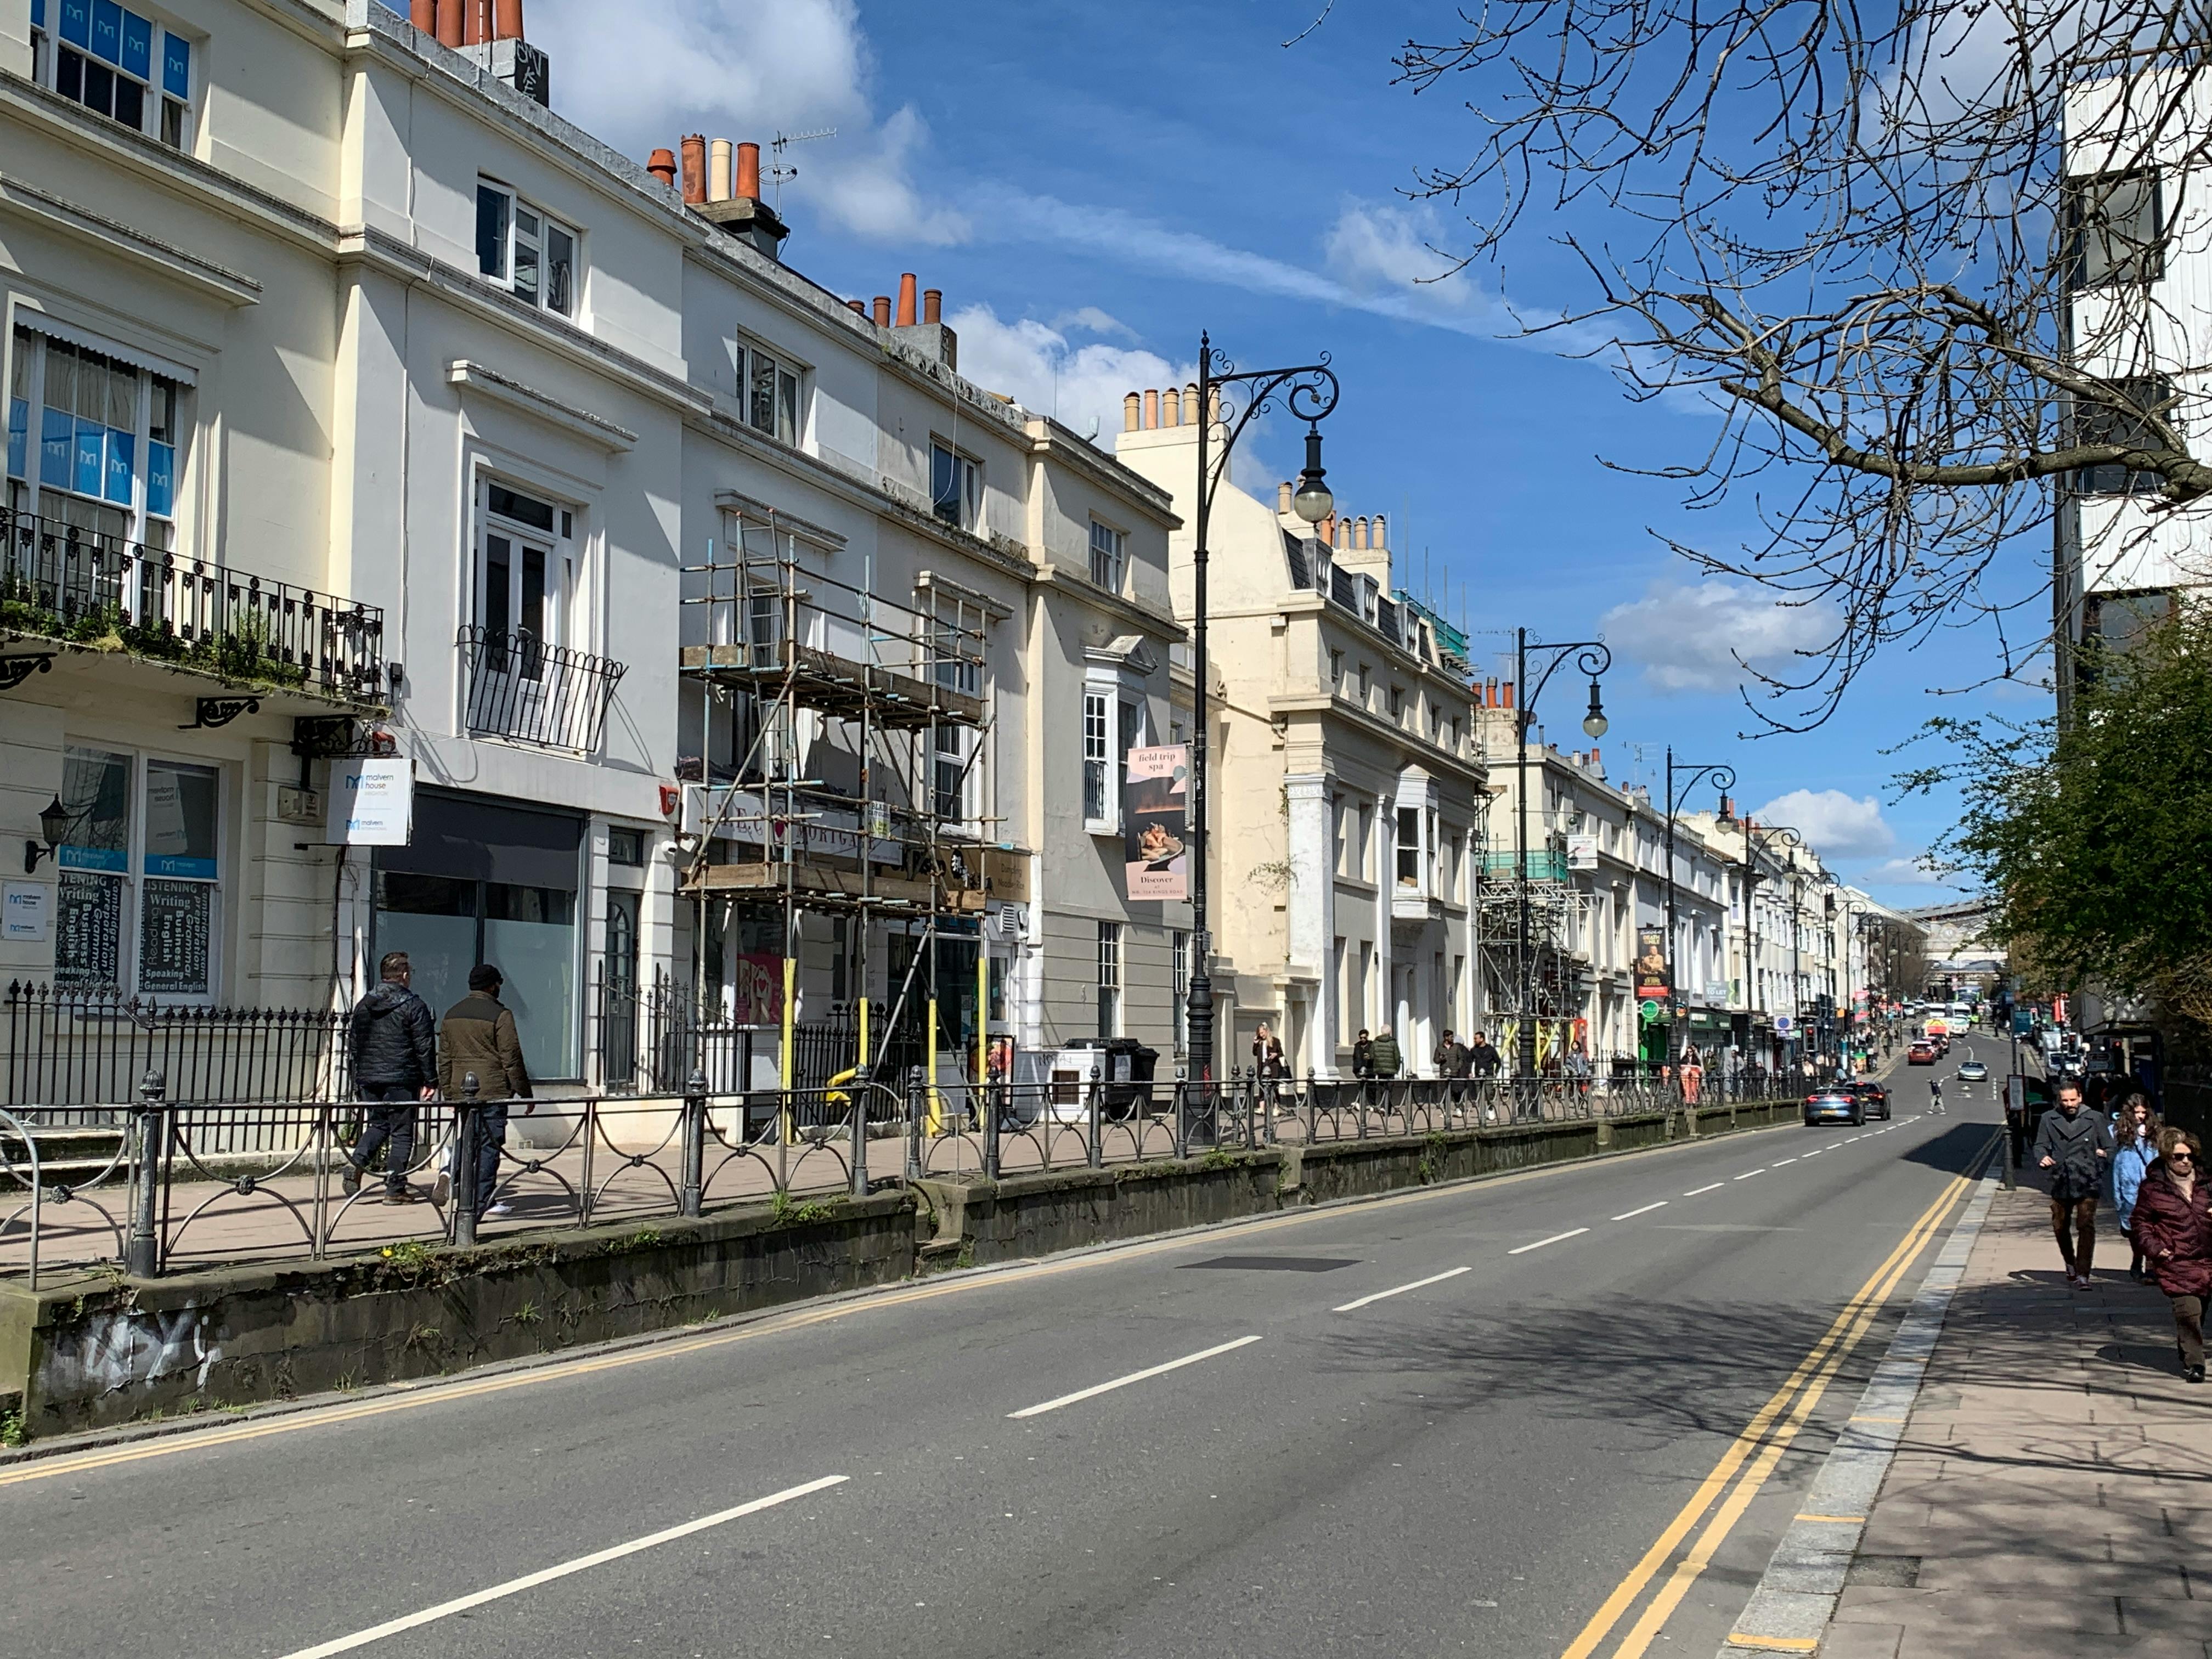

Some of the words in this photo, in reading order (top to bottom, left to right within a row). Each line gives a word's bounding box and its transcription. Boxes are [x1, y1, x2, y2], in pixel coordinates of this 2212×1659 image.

[1139, 753, 1157, 762] field
[1160, 752, 1175, 761] trip
[150, 894, 191, 911] Writing
[200, 885, 208, 945] Cambridge
[66, 908, 79, 958] English
[92, 908, 103, 975] Grammar
[147, 907, 162, 966] Reading
[161, 914, 173, 963] English
[174, 910, 184, 968] Business
[185, 913, 194, 978] Grammar
[144, 981, 178, 991] General
[179, 981, 206, 993] English
[145, 969, 184, 980] Speaking
